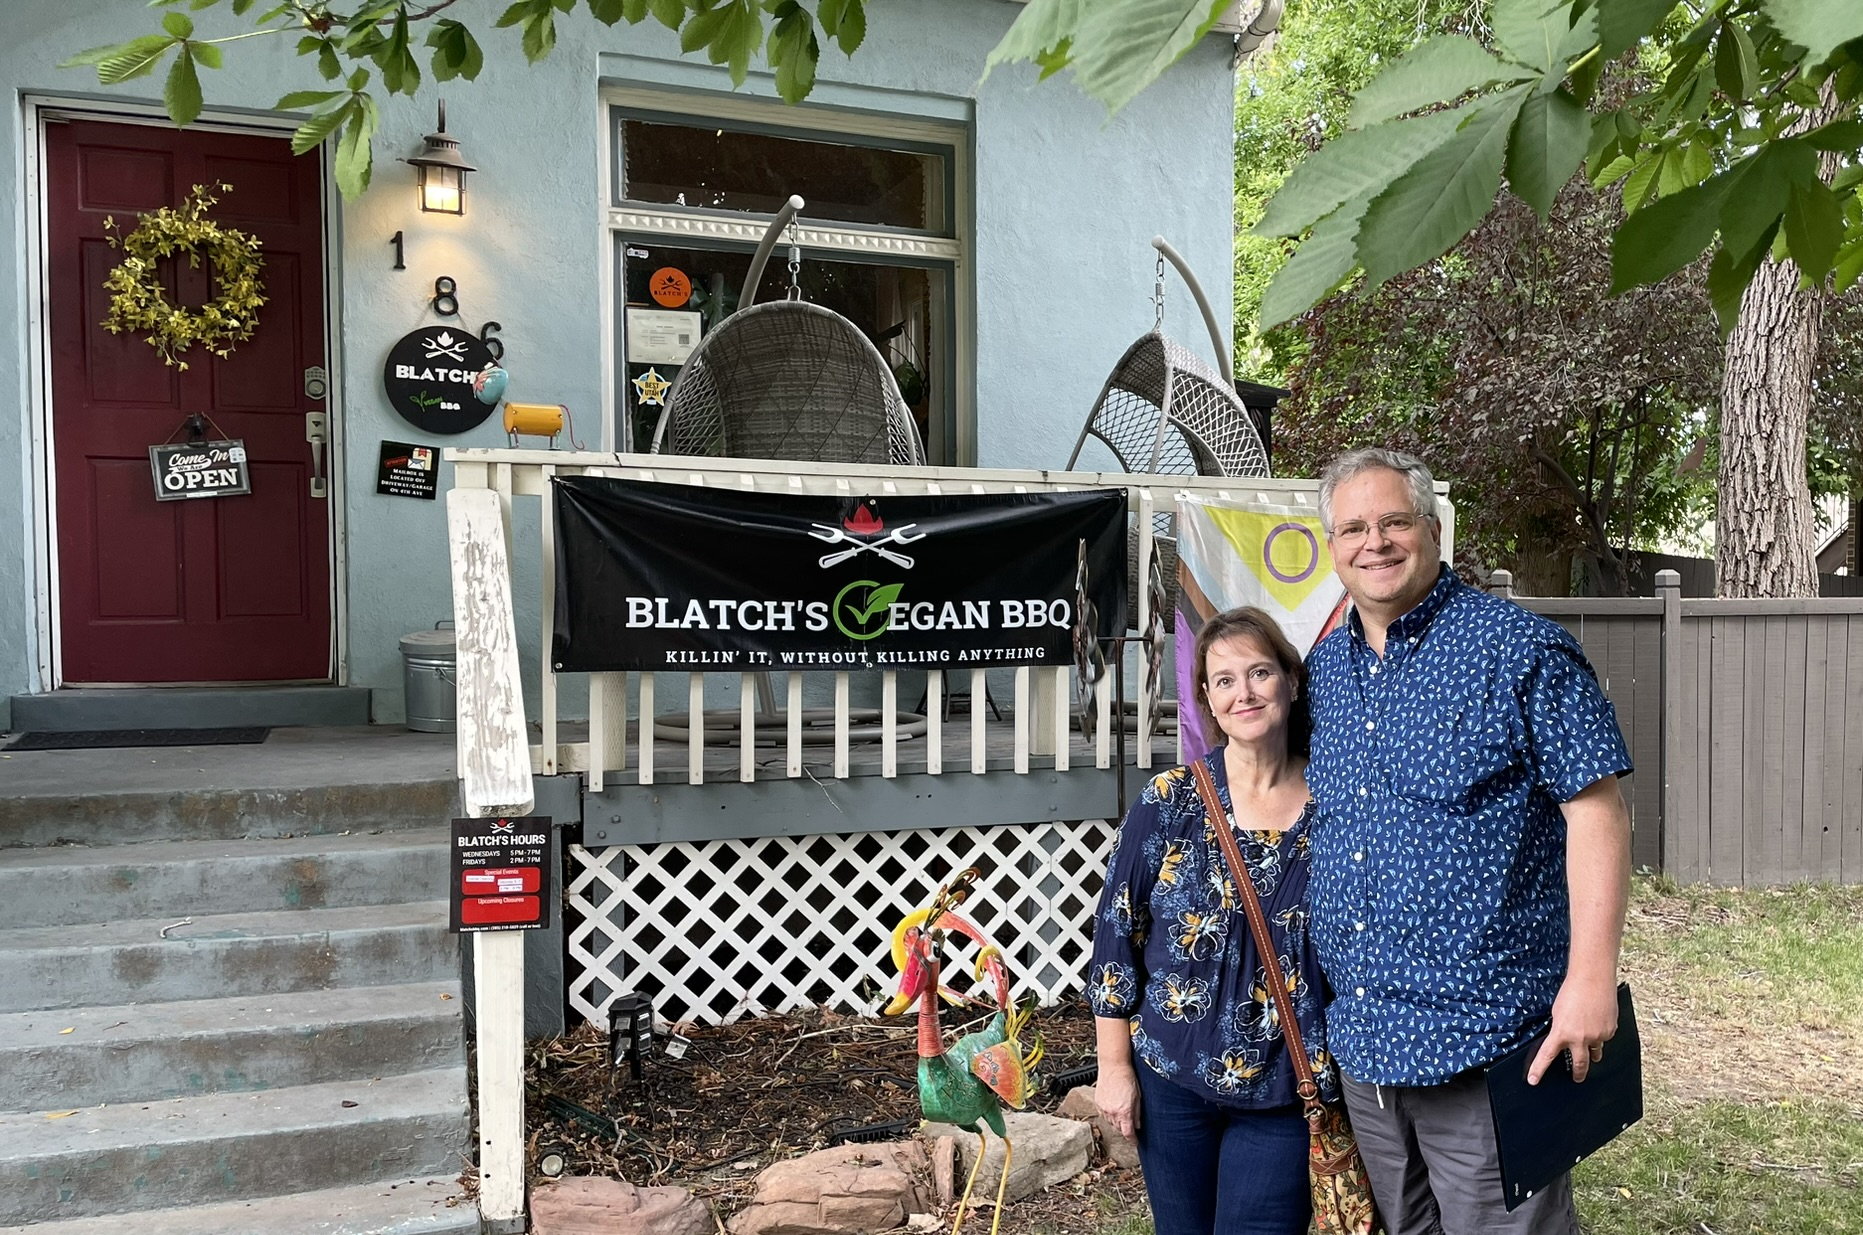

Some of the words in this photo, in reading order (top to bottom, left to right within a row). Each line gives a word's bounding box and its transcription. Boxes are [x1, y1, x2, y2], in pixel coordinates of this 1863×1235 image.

[390, 230, 406, 270] 1
[433, 275, 459, 316] 8
[480, 321, 504, 361] 6
[644, 381, 659, 389] BEST
[644, 389, 659, 397] UTAH
[440, 402, 461, 410] BBQ
[168, 453, 206, 467] Come
[209, 448, 230, 462] In
[164, 468, 238, 490] OPEN
[625, 597, 829, 632] BLATCH'S
[1000, 598, 1071, 630] BBQ
[665, 650, 740, 664] KILLIN'
[748, 650, 773, 666] IT,
[780, 651, 869, 664] WITHOUT
[876, 650, 951, 663] KILLING
[958, 647, 1046, 661] ANYTHING
[457, 835, 509, 847] BLATCH'S
[510, 834, 546, 845] HOURS
[462, 850, 500, 858] WEDNESDAYS
